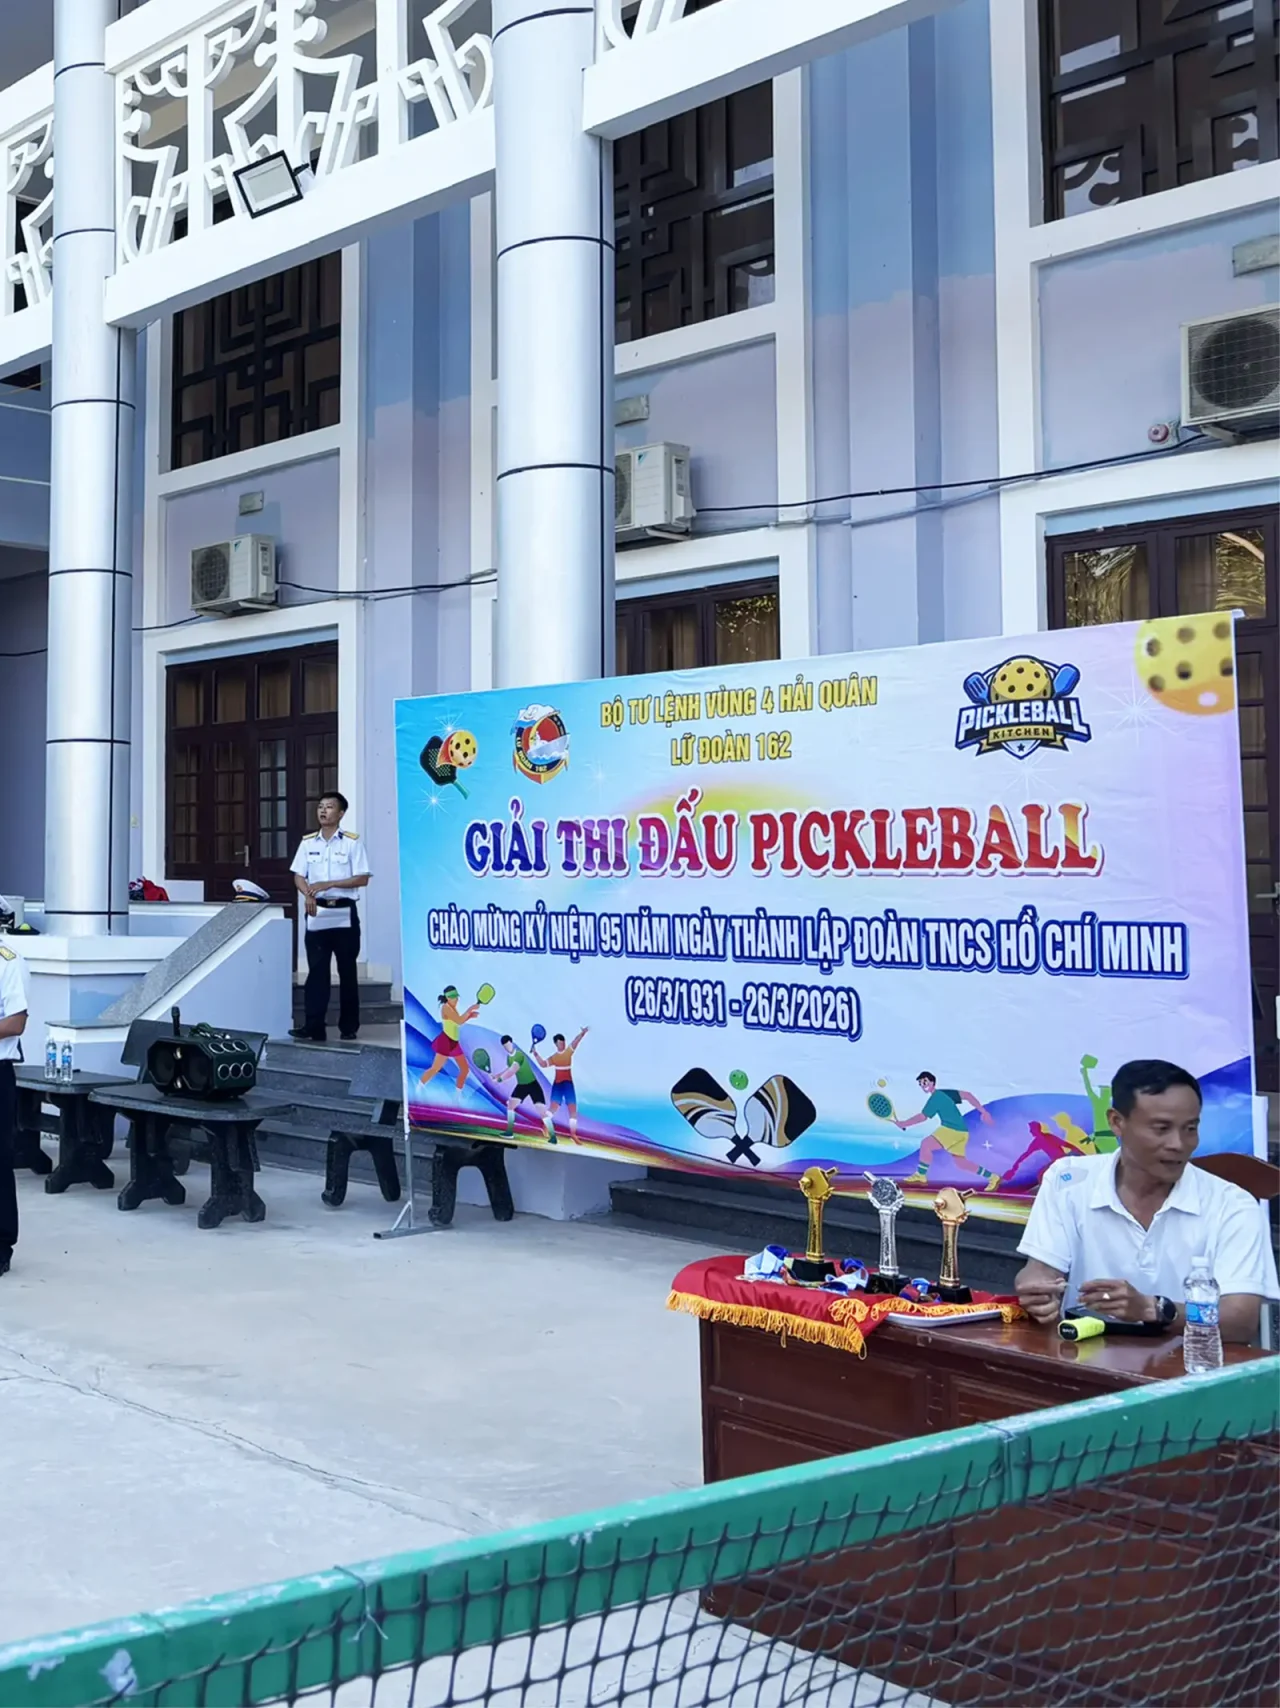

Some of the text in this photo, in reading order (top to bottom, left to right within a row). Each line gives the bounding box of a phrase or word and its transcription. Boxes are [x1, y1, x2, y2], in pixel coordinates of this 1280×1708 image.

[600, 696, 624, 732] BỘ
[628, 696, 652, 725] TƯ
[654, 690, 701, 728] LỆNH
[705, 685, 757, 719] VÙNG
[761, 686, 774, 714] 4
[779, 674, 813, 713] HẢI
[819, 672, 878, 712] QUÂN
[958, 700, 1088, 743] PICKLEBALL
[670, 729, 792, 766] LỮ ĐOÀN 162
[992, 727, 1051, 740] KITCHEN
[463, 787, 1103, 878] GIẢI THI ĐẤU PICKLEBALL
[428, 901, 1185, 974] CHÀO MỪNG KỶ NIỆM 95 NĂM NGÀY THÀNH LẬP ĐOÀN TNCS HỒ CHÍ MINH
[626, 978, 726, 1022] (26/3/1931
[745, 985, 860, 1036] 26/3/2026)
